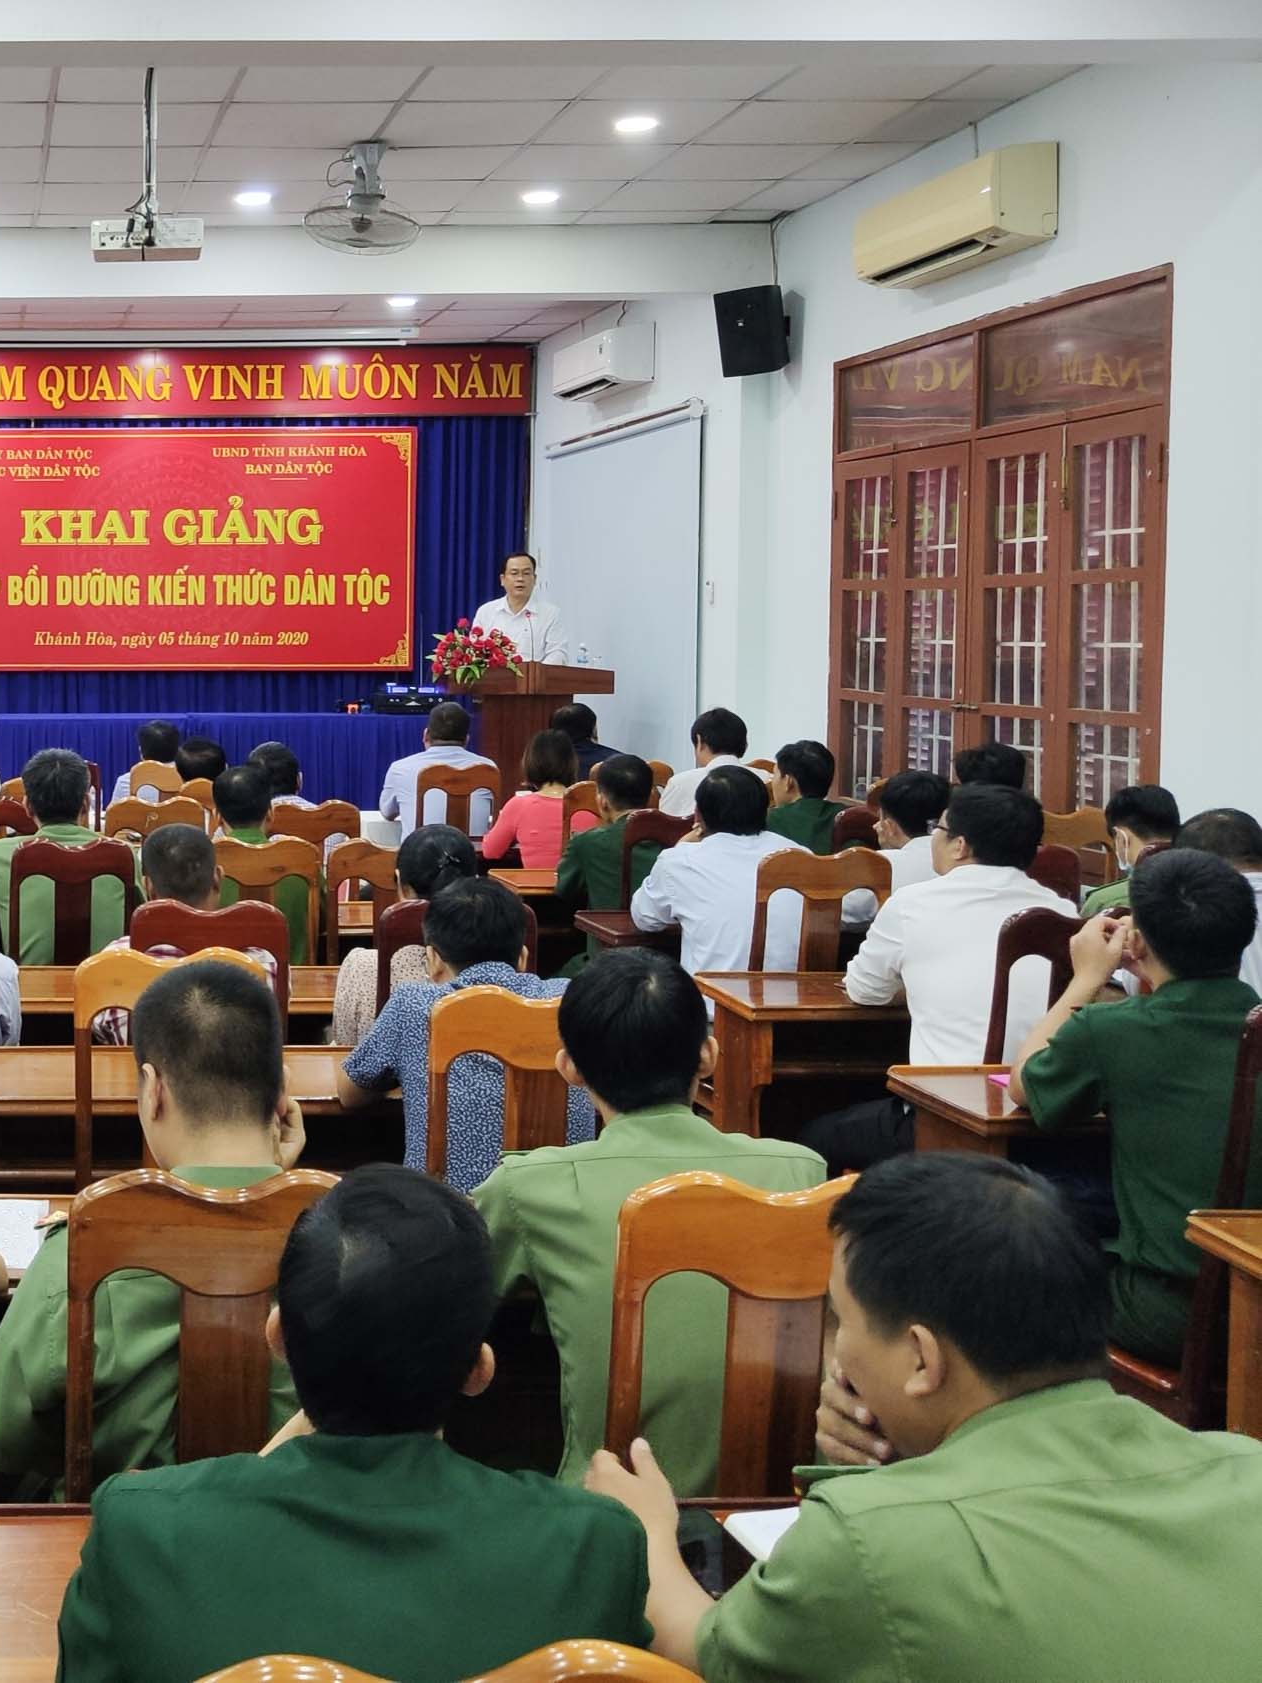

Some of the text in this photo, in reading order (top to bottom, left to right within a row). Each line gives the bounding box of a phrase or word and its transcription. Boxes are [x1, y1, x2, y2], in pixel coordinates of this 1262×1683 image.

[38, 364, 173, 410] QUANG
[183, 364, 285, 401] VINH
[299, 353, 420, 401] MUÔN
[432, 353, 524, 400] NĂM
[6, 449, 33, 460] BAN
[36, 446, 63, 460] DÂN
[66, 446, 93, 463] TỘC
[212, 443, 367, 458] UBND TỈNH KHÁNH HÒA
[9, 464, 40, 479] VIỆN
[43, 463, 71, 477] DÂN
[73, 463, 101, 479] TỘC
[245, 461, 333, 476] BAN DÂN TỘC
[21, 495, 324, 546] KHAI GIẢNG
[8, 564, 49, 606] BỒI
[56, 568, 141, 606] DƯỠNG
[148, 564, 206, 606] KIẾN
[213, 567, 277, 606] THỨC
[284, 567, 336, 606] DÂN
[343, 567, 390, 613] TỘC
[33, 631, 309, 649] Khánh Hòa, ngày 05 tháng 10 năm 2020
